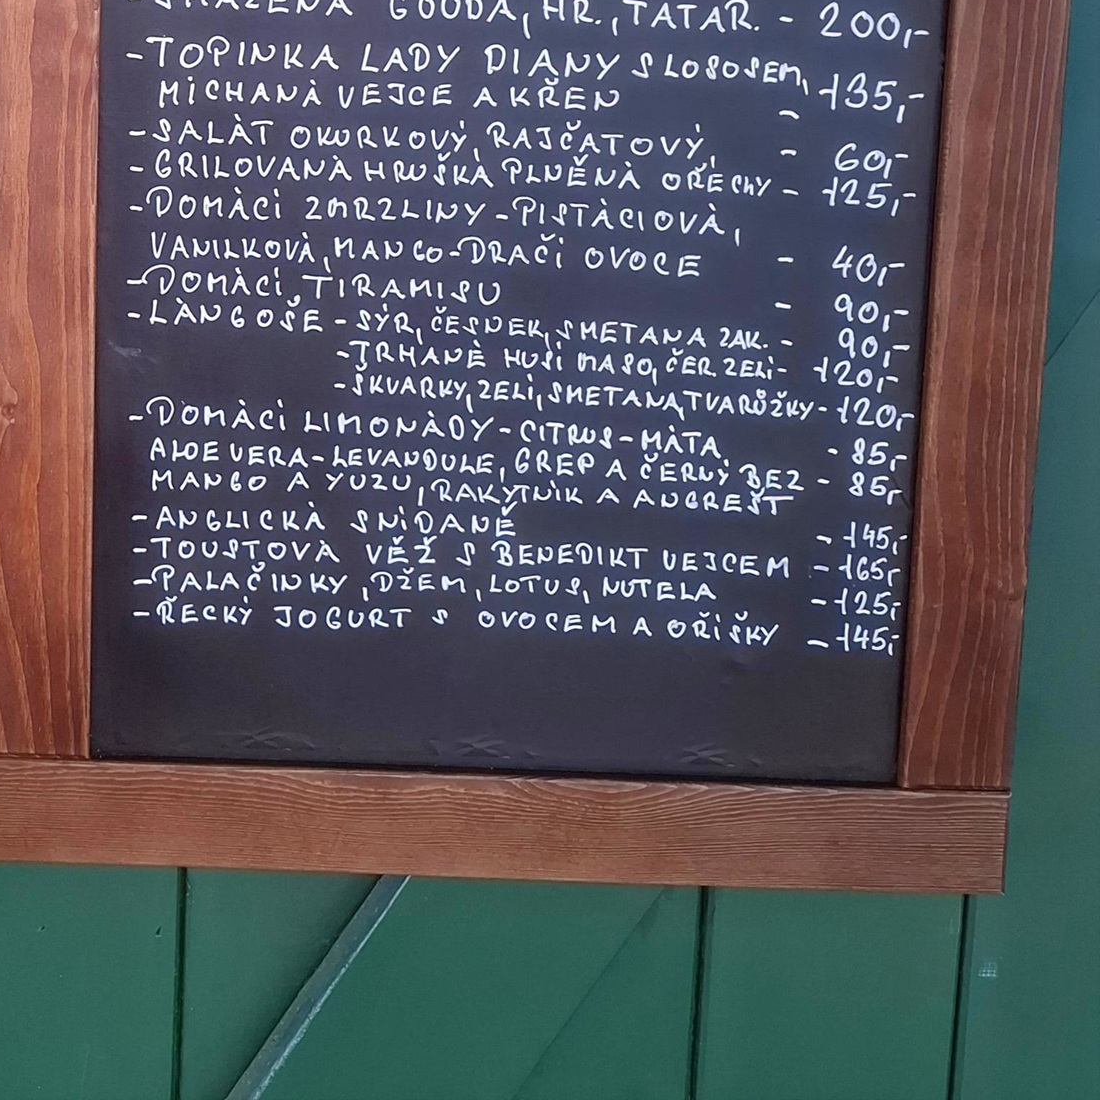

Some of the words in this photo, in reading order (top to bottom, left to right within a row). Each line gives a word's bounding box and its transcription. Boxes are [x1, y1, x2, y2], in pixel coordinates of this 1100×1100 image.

[145, 35, 340, 70] TOPINKA
[360, 42, 461, 73] LADY
[484, 43, 621, 81] DIANY
[631, 52, 654, 79] S
[338, 82, 453, 109] VEJCE
[472, 86, 498, 108] A
[509, 77, 620, 112] KŘEN
[305, 195, 486, 226] ZMRZLINY
[584, 245, 702, 278] OVOCE
[301, 273, 501, 306] TIRAMISU
[555, 319, 707, 350] SMETANA
[682, 388, 815, 421] TVARŮŽKY
[149, 436, 220, 463] ALOE
[514, 446, 595, 477] GREP
[604, 458, 627, 482] A
[738, 463, 805, 491] BEZ
[151, 469, 267, 492] MANGO
[286, 471, 310, 493] A
[596, 487, 620, 504] A
[632, 486, 794, 516] ANGREŠT
[365, 535, 438, 565] VĚŽ
[455, 541, 476, 567] S
[490, 539, 649, 570] BENEDIKT
[662, 549, 790, 579] VEJCEM
[602, 576, 717, 602] NUTELA
[273, 605, 412, 630] JOGURT
[431, 608, 449, 625] S
[477, 610, 617, 634] OVOCEM
[632, 616, 653, 637] A
